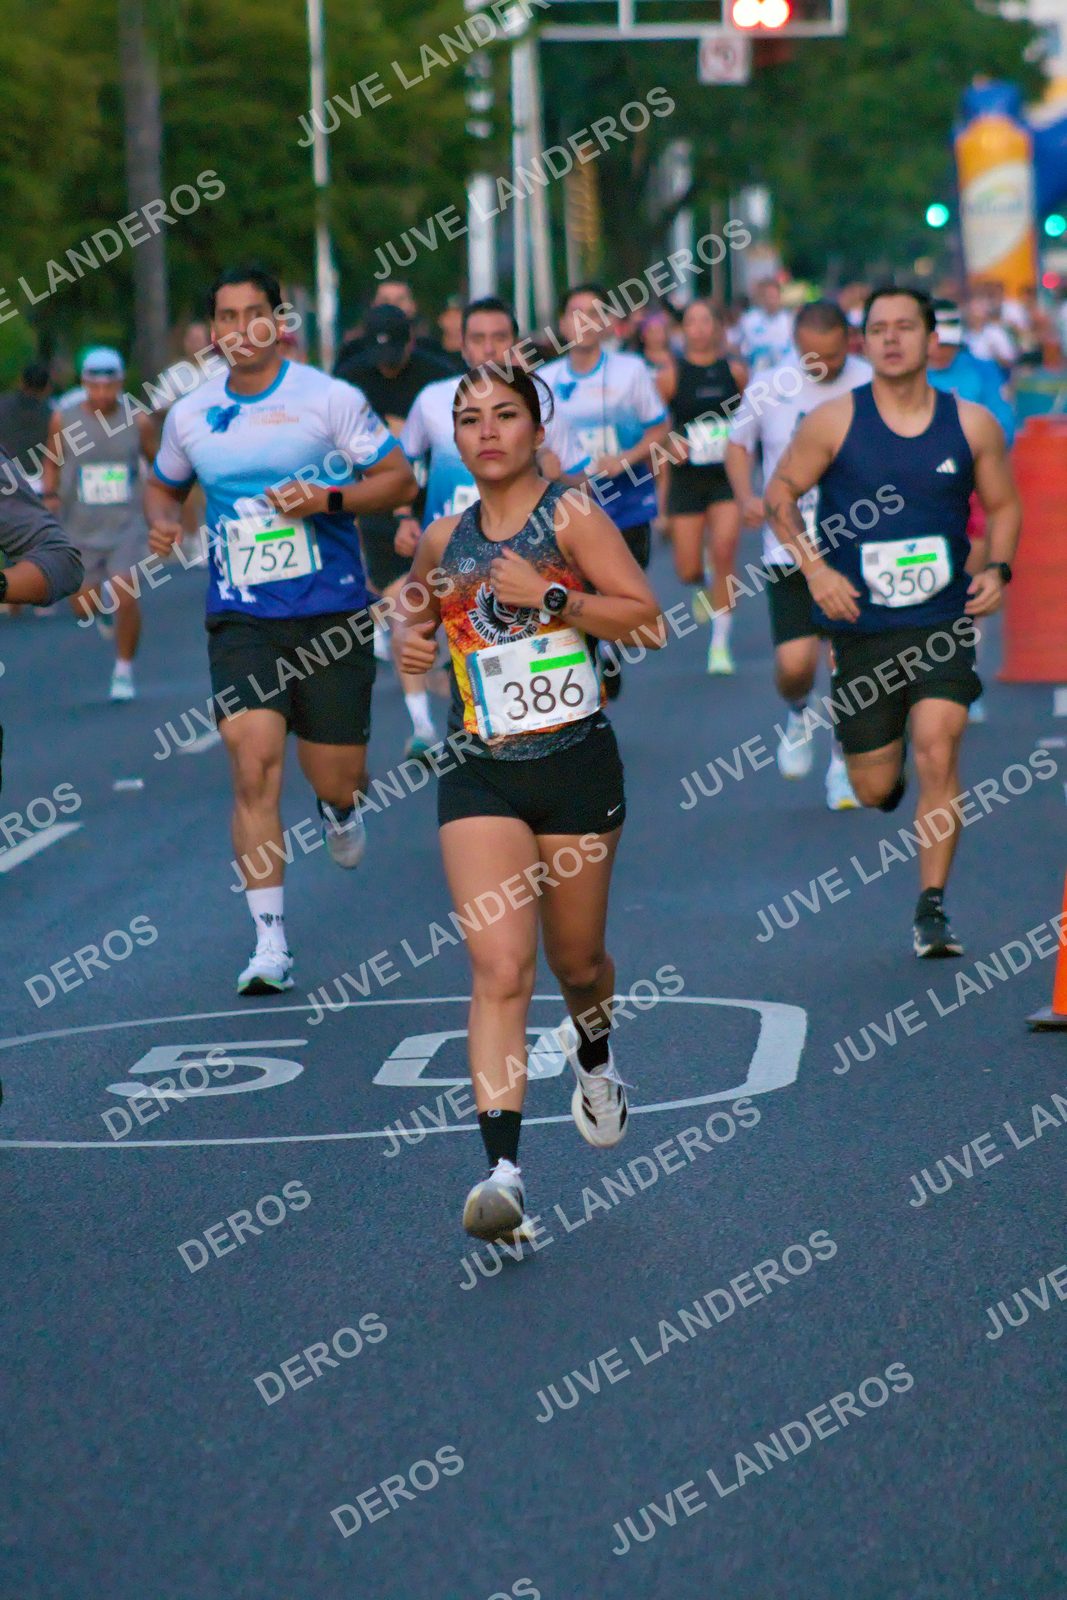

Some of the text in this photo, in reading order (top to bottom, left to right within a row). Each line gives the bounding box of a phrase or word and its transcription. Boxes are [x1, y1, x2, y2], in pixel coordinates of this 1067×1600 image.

[239, 540, 299, 577] 752
[878, 567, 936, 599] 350
[468, 610, 496, 644] FABIAN
[503, 668, 584, 721] 386
